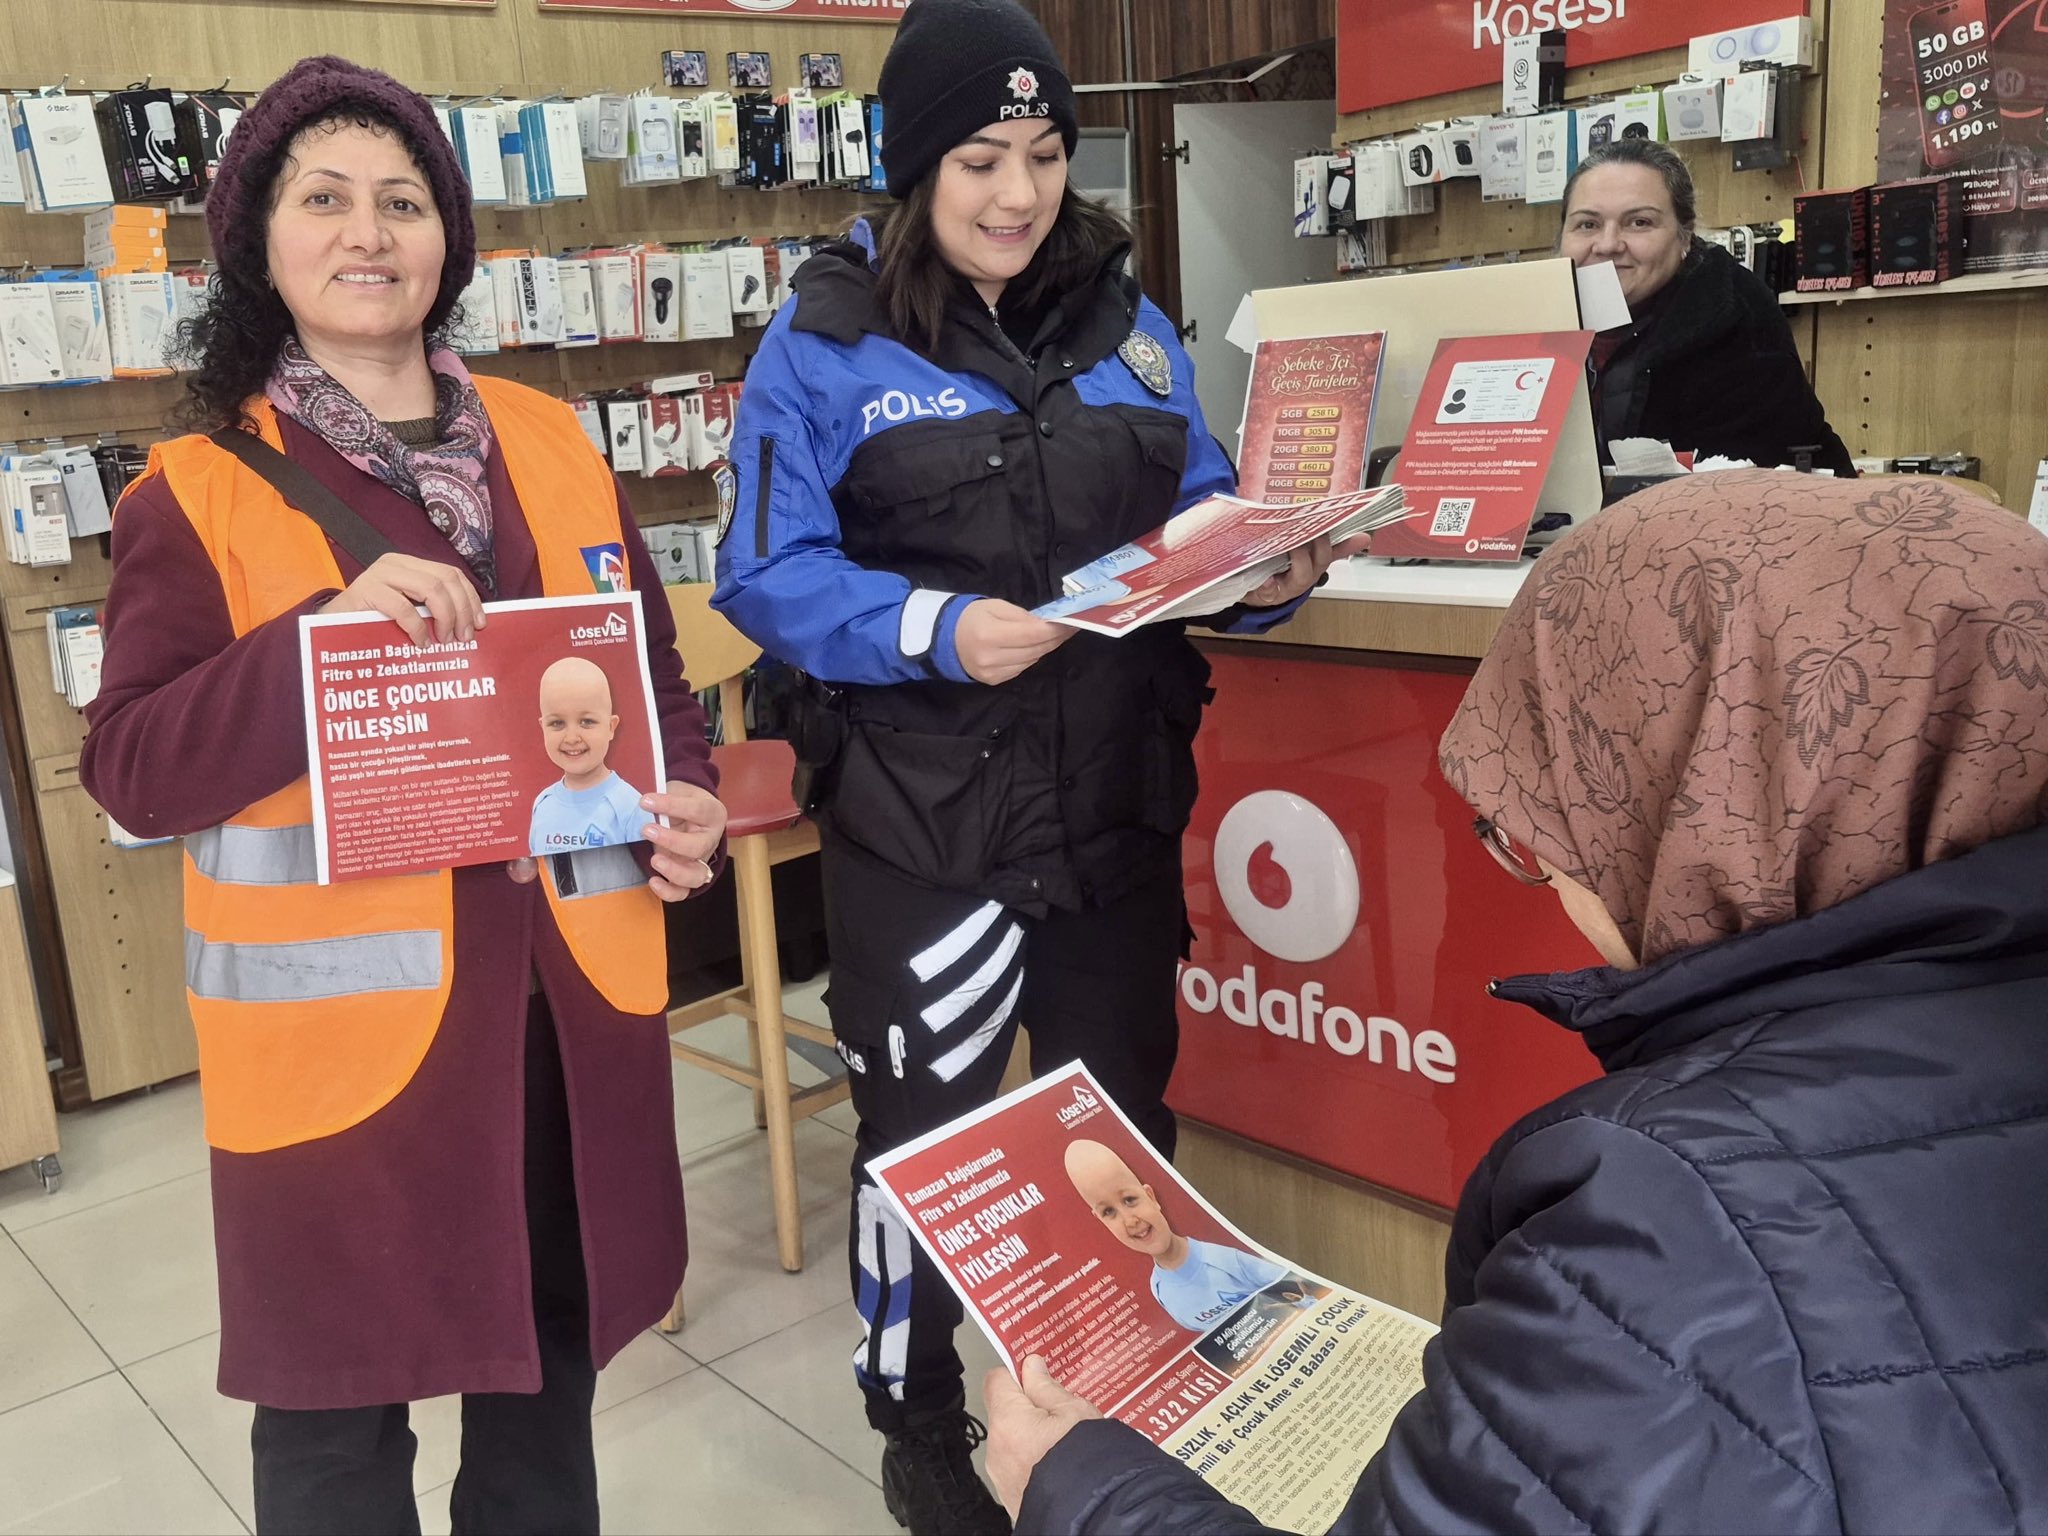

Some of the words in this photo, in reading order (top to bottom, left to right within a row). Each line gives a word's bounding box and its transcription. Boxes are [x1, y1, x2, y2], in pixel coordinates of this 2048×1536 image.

[1918, 33, 1948, 58] 50
[1952, 20, 1985, 46] GB
[1922, 59, 1963, 84] 3000
[1966, 49, 1988, 69] DK
[1931, 120, 1983, 150] 1.190
[1986, 121, 1998, 131] TL
[1277, 354, 1325, 378] Şebeke
[1267, 376, 1301, 396] Geçiş
[1302, 372, 1359, 391] Tarifeleri
[1281, 409, 1303, 419] 5GB
[1277, 428, 1301, 437] 10GB
[1273, 445, 1298, 454] 20GB
[1271, 463, 1296, 471] 30GB
[1480, 542, 1517, 551] vodafone
[570, 626, 610, 640] LÖSEV
[320, 648, 381, 664] Ramazan
[321, 668, 353, 683] Fitre
[356, 666, 373, 679] ve
[376, 657, 469, 677] Zekatlarınızla
[323, 687, 380, 713] ÖNCE
[386, 677, 496, 712] ÇOCUKLAR
[326, 709, 429, 743] İYİLEŞSİN
[545, 833, 587, 846] LÖSEV
[1176, 963, 1457, 1084] odafone
[1055, 1100, 1087, 1123] LÖSEV
[903, 1177, 949, 1208] Ramazan
[944, 1147, 1006, 1185] Bağışlarınızla
[917, 1204, 945, 1226] Fitre
[941, 1199, 957, 1214] ve
[951, 1169, 1012, 1208] Zekatlarınızla
[932, 1218, 982, 1257] ÖNCE
[973, 1182, 1046, 1240] ÇOCUKLAR
[954, 1233, 1030, 1289] İYİLEŞSİN
[1219, 1391, 1256, 1424] AÇLIK
[1250, 1378, 1271, 1396] VE
[1264, 1323, 1321, 1384] LÖSEMİLİ
[1314, 1296, 1356, 1328] ÇOCUK
[1232, 1347, 1248, 1362] Sen
[1179, 1368, 1222, 1405] KİŞİ
[1214, 1436, 1237, 1456] Bir
[1232, 1408, 1269, 1441] Çocuk
[1264, 1388, 1292, 1413] Anne
[1288, 1376, 1305, 1389] ve
[1299, 1336, 1339, 1378] Babası
